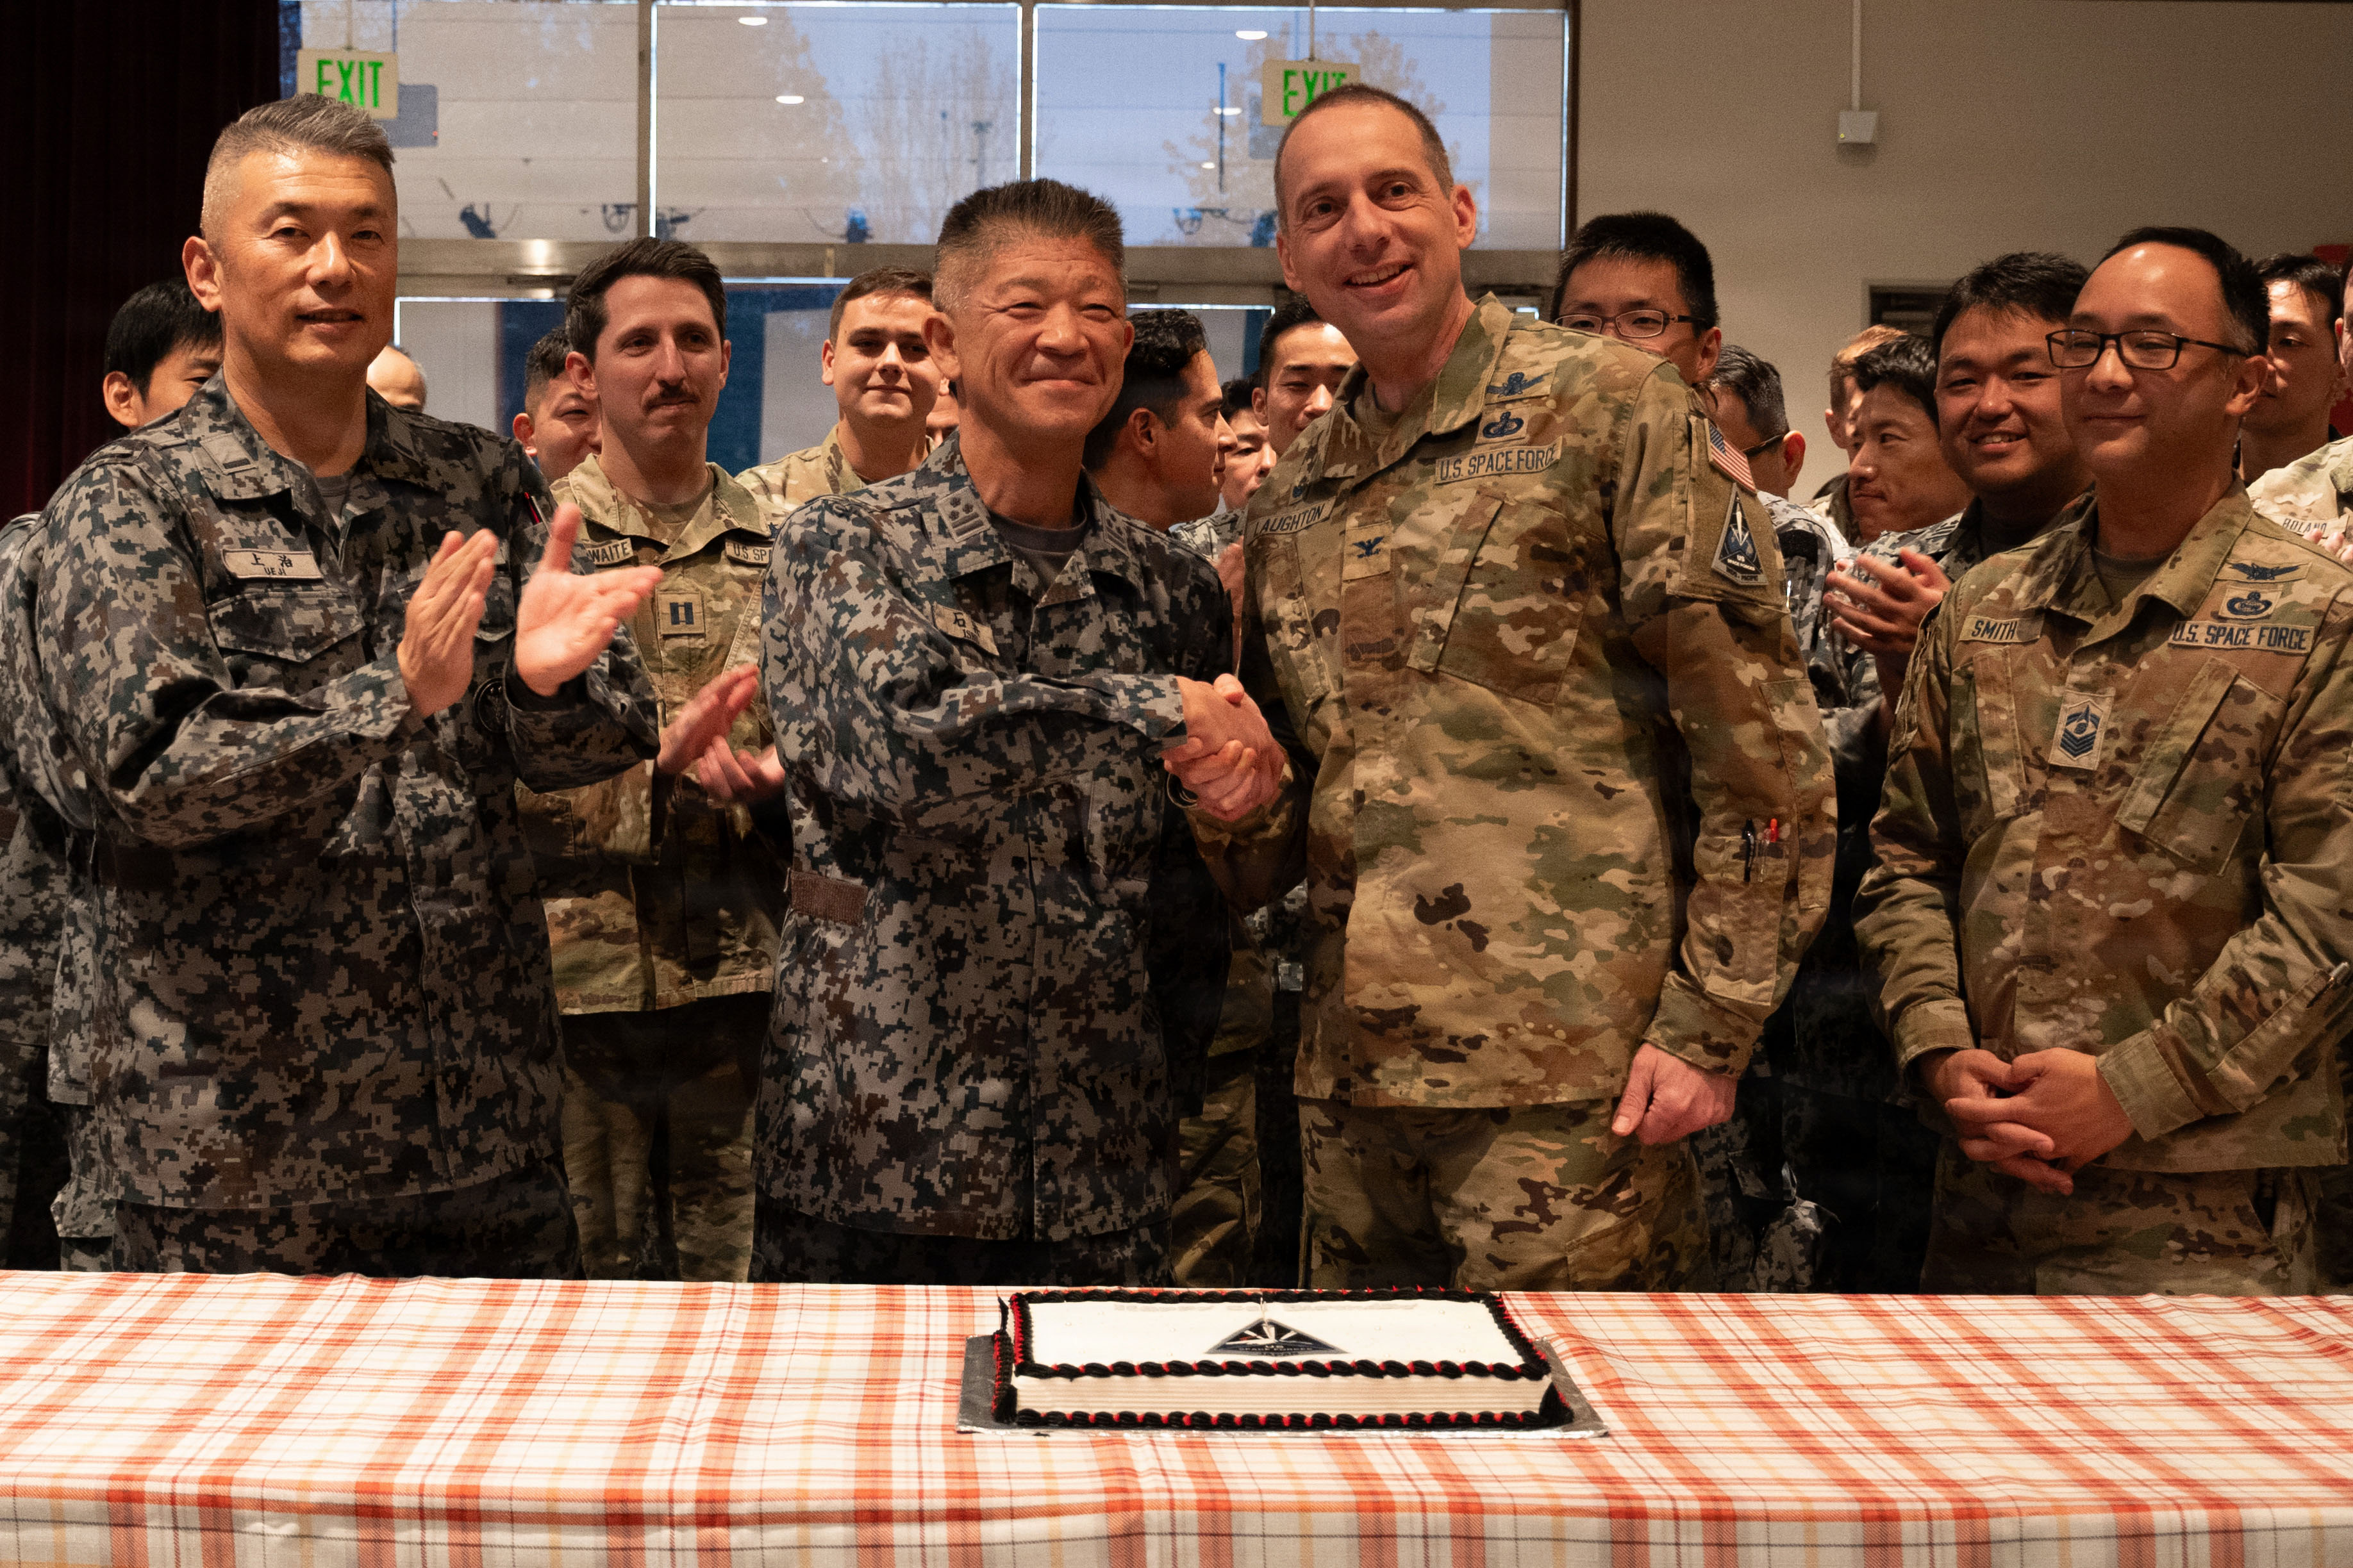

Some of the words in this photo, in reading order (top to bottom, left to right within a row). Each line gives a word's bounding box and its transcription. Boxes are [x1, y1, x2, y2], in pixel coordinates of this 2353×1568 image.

[317, 59, 383, 108] EXIT
[1440, 459, 1464, 481] U.S.
[1468, 450, 1513, 475] SPACE
[1517, 443, 1557, 471] FORCE
[1254, 504, 1325, 537] LAUGHTON
[251, 552, 293, 567] 上治
[586, 541, 630, 563] WAITE
[733, 543, 751, 560] U.S.
[752, 548, 774, 562] SP
[264, 567, 287, 575] UEJI
[1971, 620, 2018, 640] SMITH
[2172, 623, 2199, 643] U.S.
[2204, 625, 2255, 646] SPACE
[2256, 626, 2311, 650] FORCE
